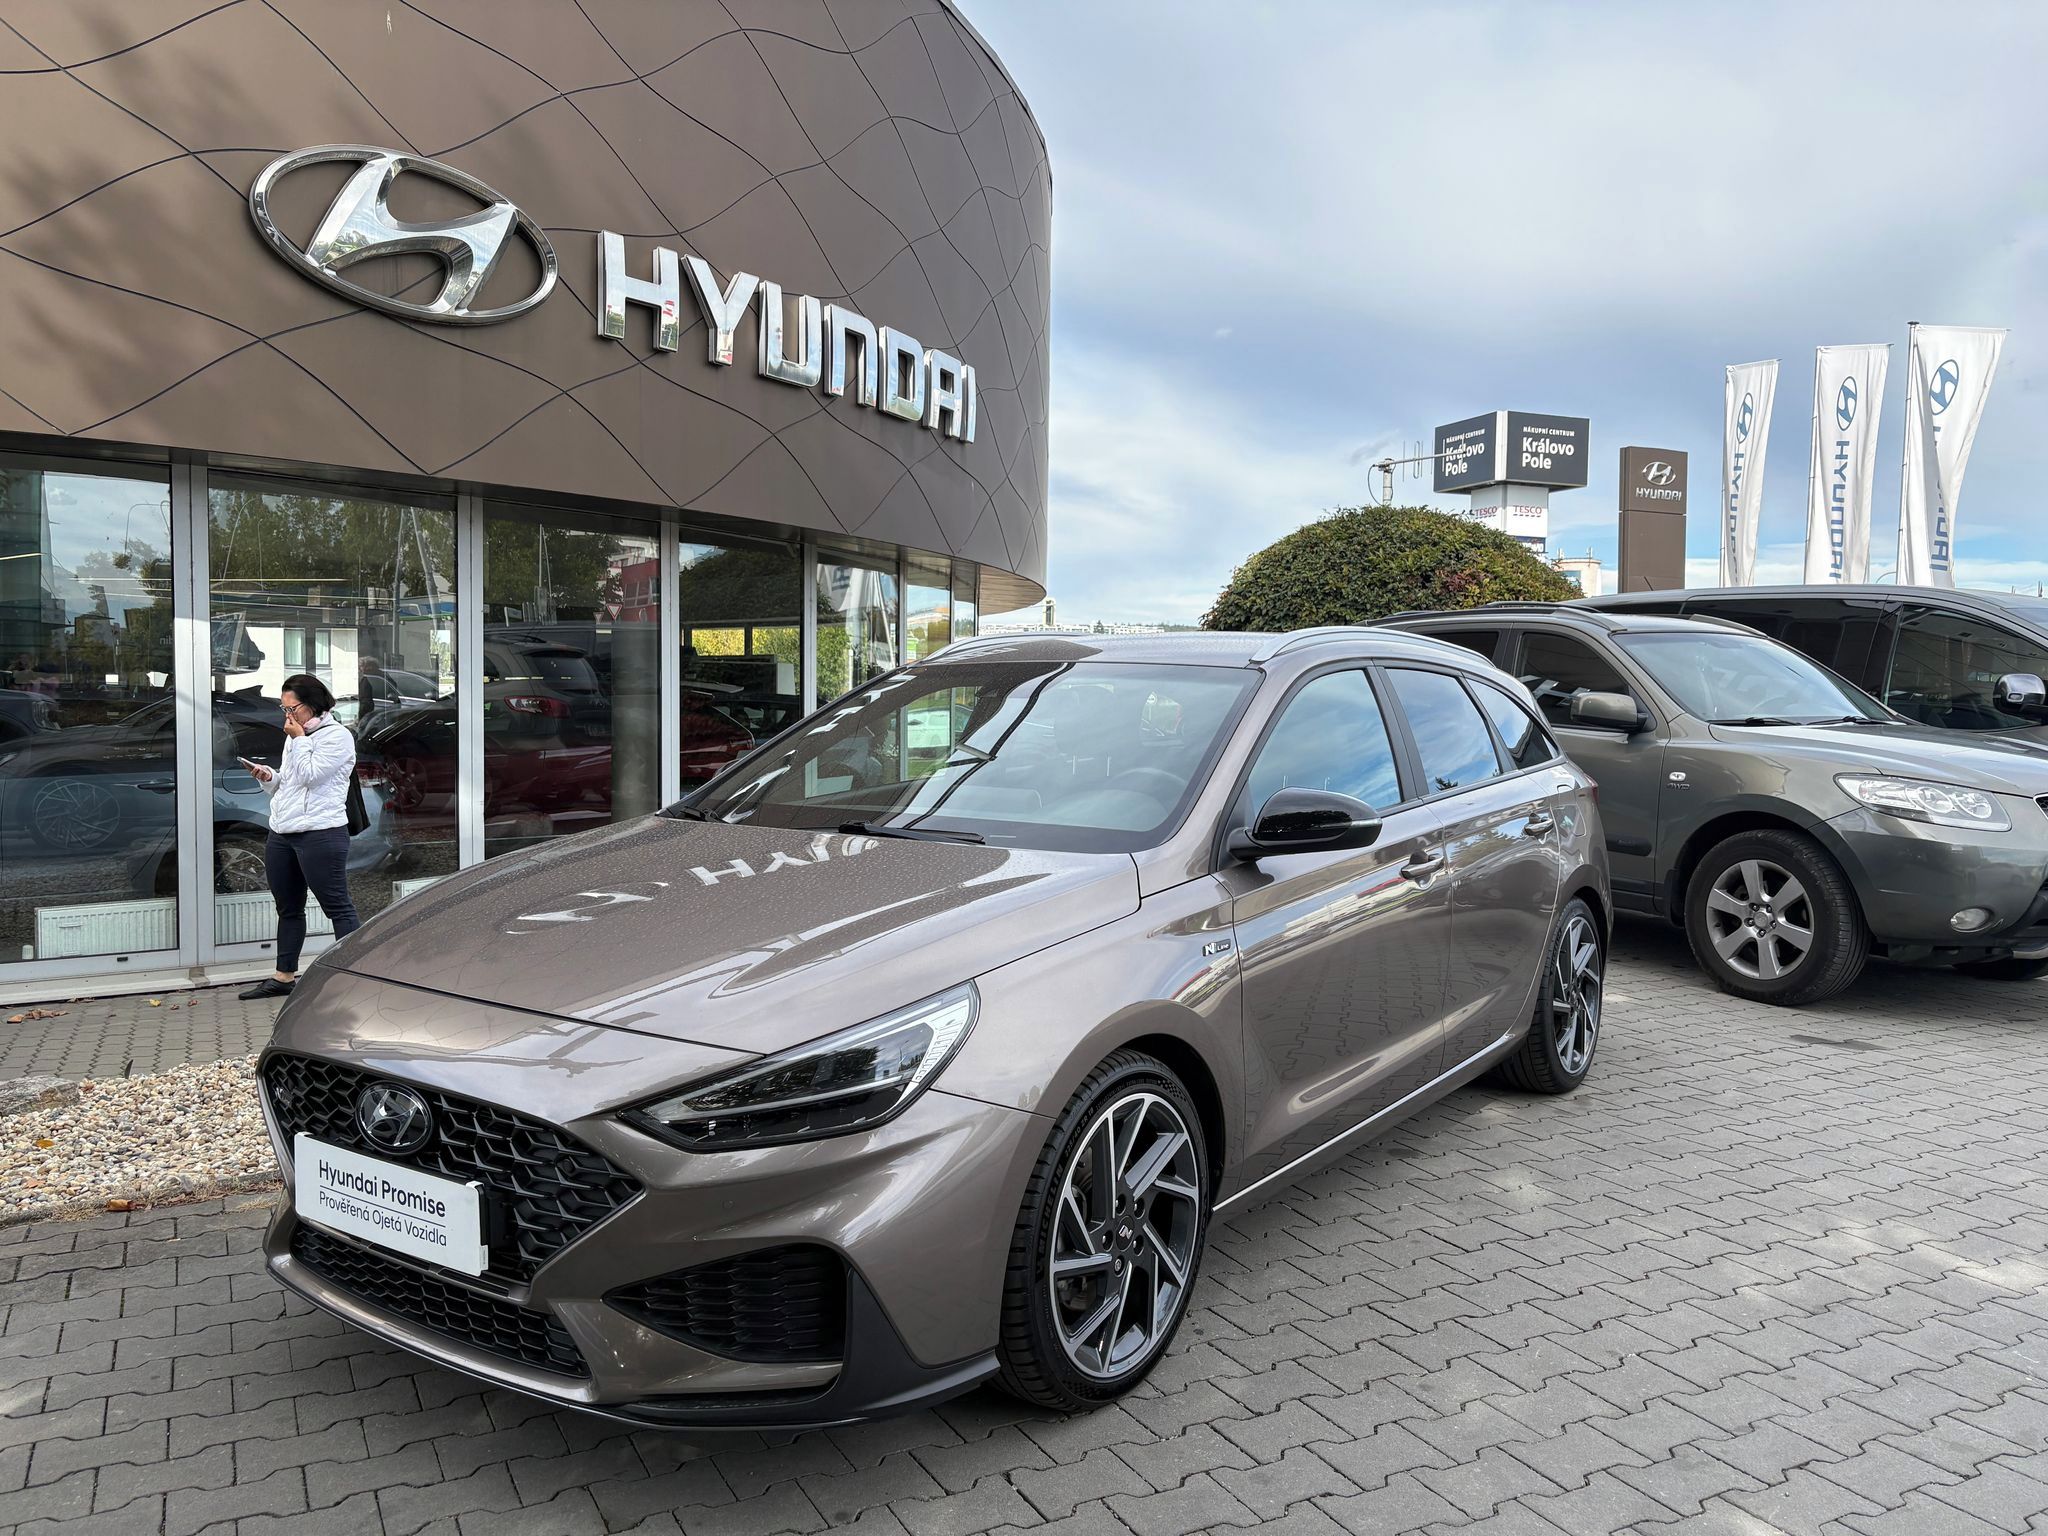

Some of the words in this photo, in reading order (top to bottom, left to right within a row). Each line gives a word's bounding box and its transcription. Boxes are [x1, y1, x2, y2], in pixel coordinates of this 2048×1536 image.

[597, 229, 978, 444] HYUNDAI
[1465, 428, 1485, 439] CENTRUM
[1523, 426, 1548, 435] NÁKUPNÍ
[1549, 429, 1575, 437] CENTRUM
[1522, 437, 1575, 456] Královo
[1445, 461, 1468, 477] Pole
[1522, 453, 1552, 469] Pole
[1636, 487, 1682, 501] HYUNDAI
[1475, 506, 1498, 516] TESCO
[1513, 505, 1542, 515] TESCO
[1829, 440, 1850, 579] HYUNDAI
[319, 1159, 378, 1197] Hyundai
[381, 1180, 446, 1218] Promise
[319, 1191, 370, 1221] Prověřená
[372, 1210, 402, 1233] Ojetá
[404, 1219, 447, 1246] Vozidla
